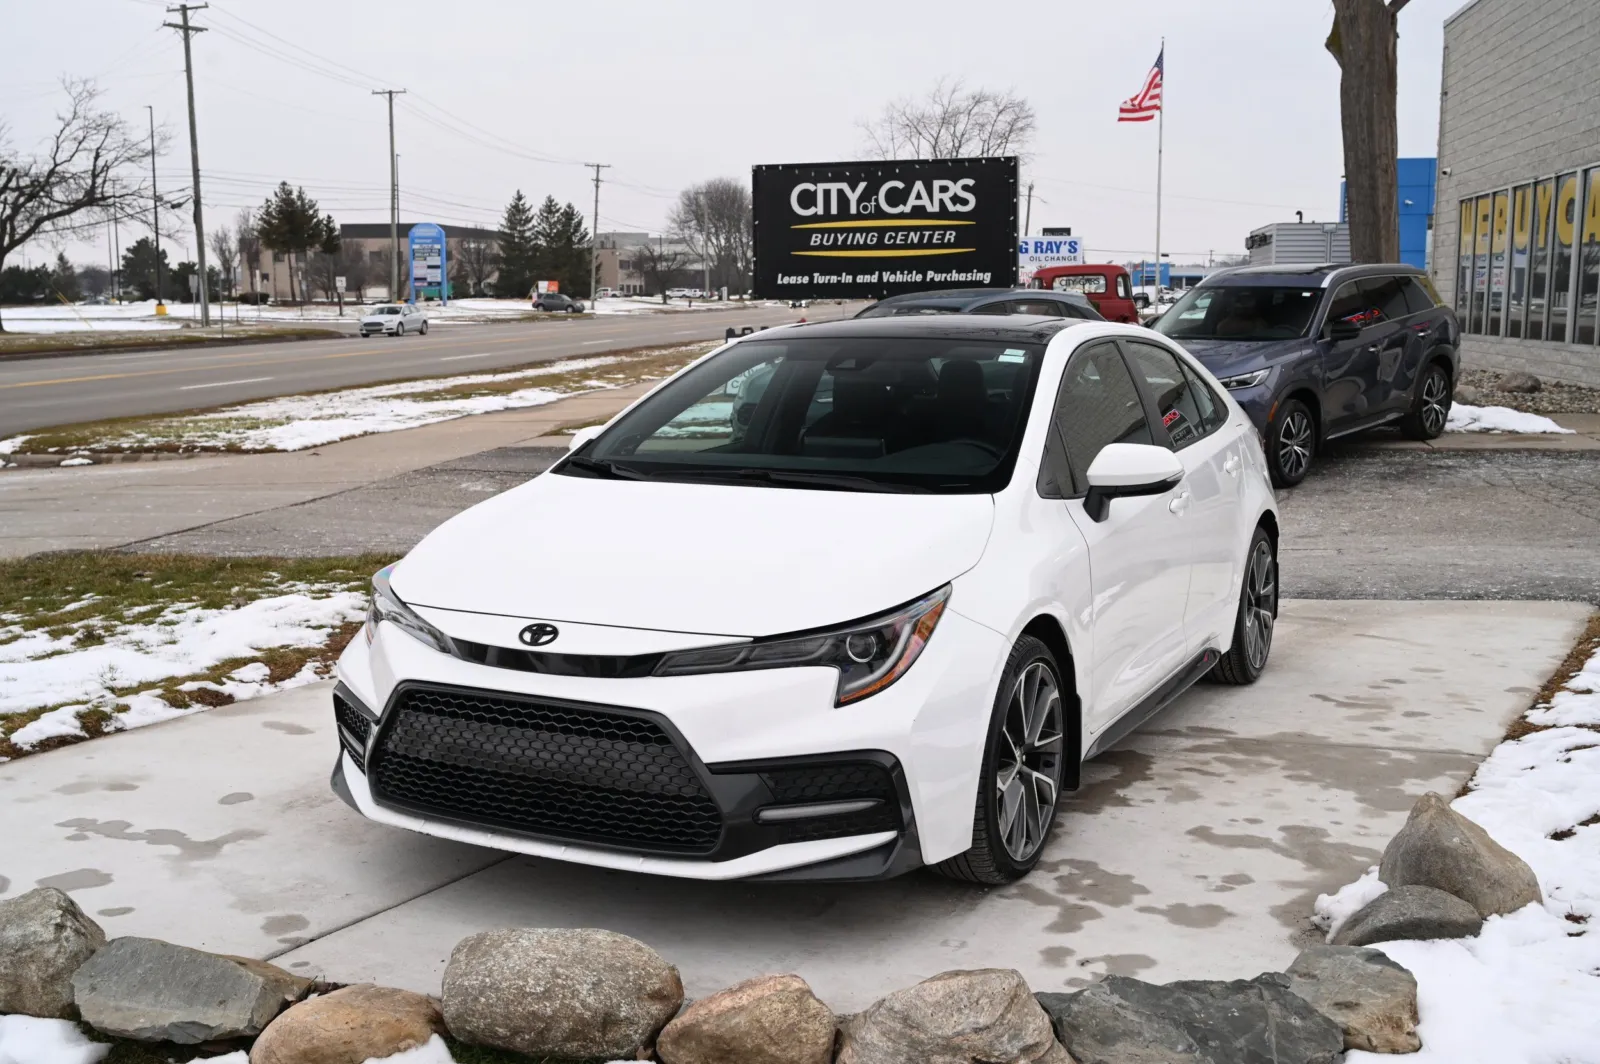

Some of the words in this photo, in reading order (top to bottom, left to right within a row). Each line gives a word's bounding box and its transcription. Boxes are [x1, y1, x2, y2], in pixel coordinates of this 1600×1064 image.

[790, 181, 867, 217] CITY
[859, 196, 877, 214] of
[878, 178, 976, 215] CARS
[1493, 184, 1553, 254] BUY
[810, 232, 878, 246] BUYING
[884, 230, 956, 244] CENTER
[1034, 240, 1078, 254] RAY'S
[777, 273, 809, 285] Lease
[813, 272, 853, 284] Turn-In
[856, 271, 879, 284] and
[882, 270, 922, 283] Vehicle
[926, 268, 992, 284] Purchasing
